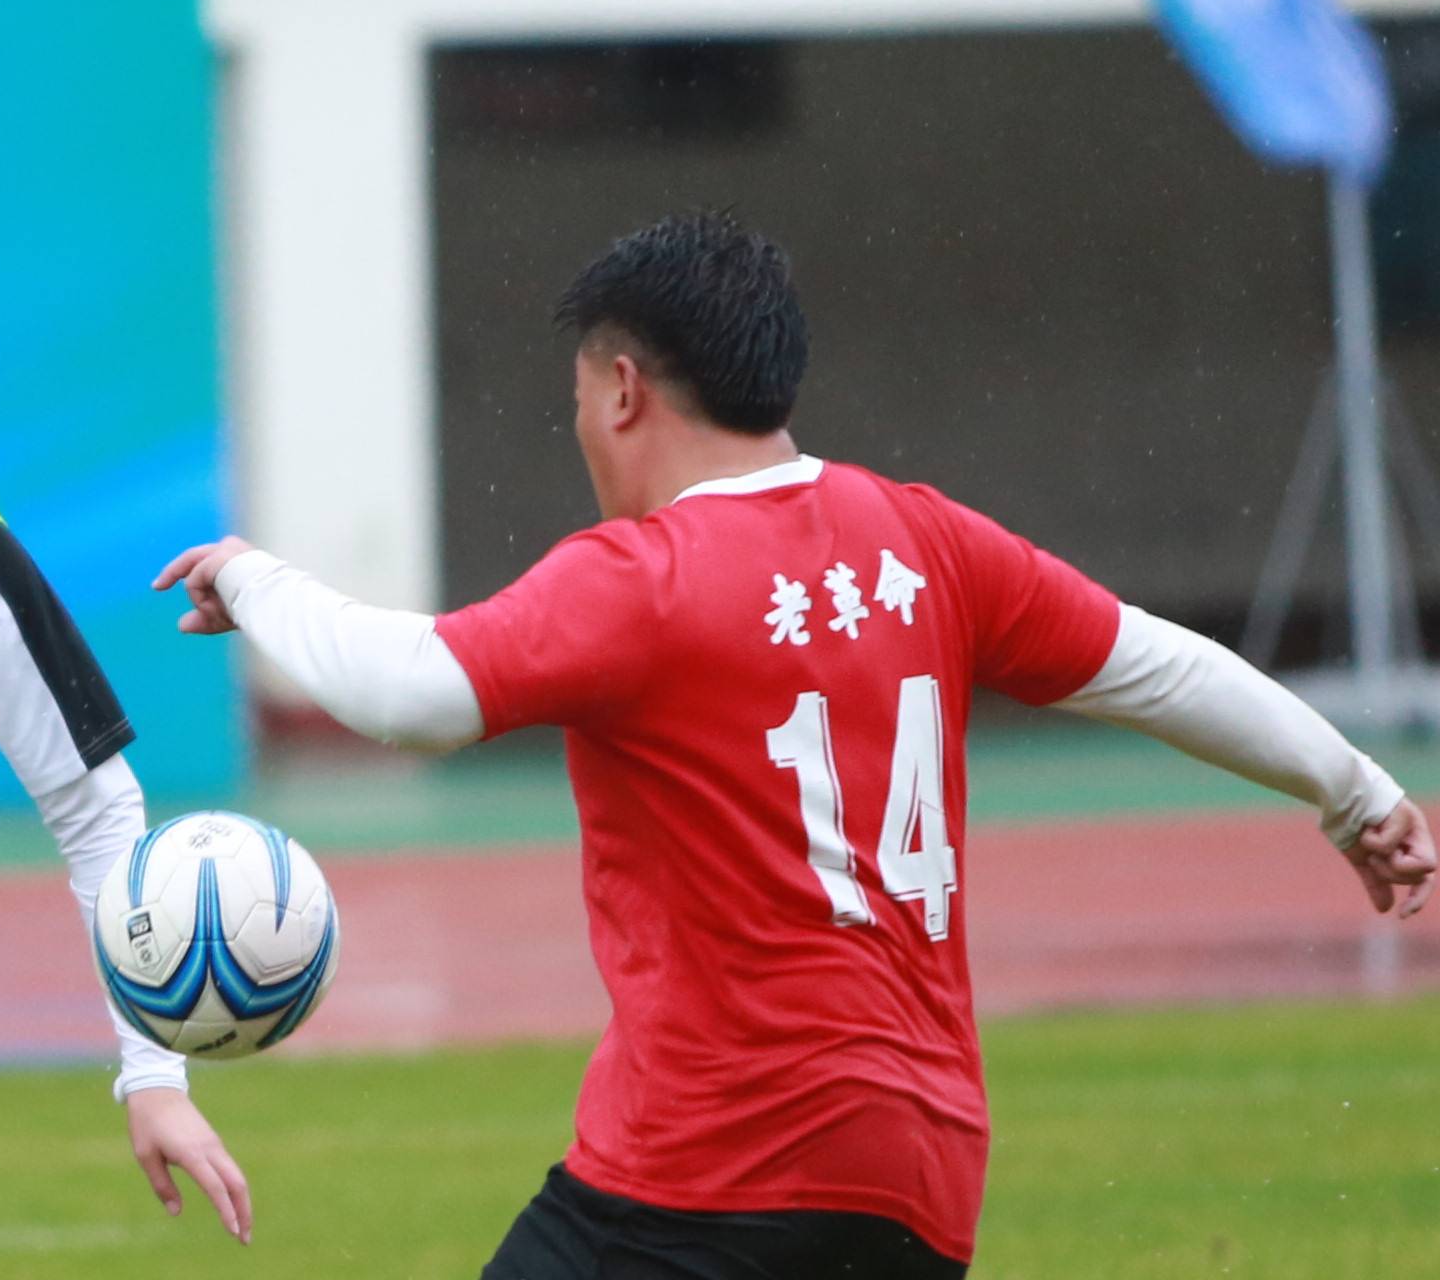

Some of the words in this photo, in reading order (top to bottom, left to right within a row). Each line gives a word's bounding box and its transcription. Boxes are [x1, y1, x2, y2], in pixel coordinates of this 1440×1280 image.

[764, 548, 926, 646] 老革命
[765, 673, 957, 943] 14
